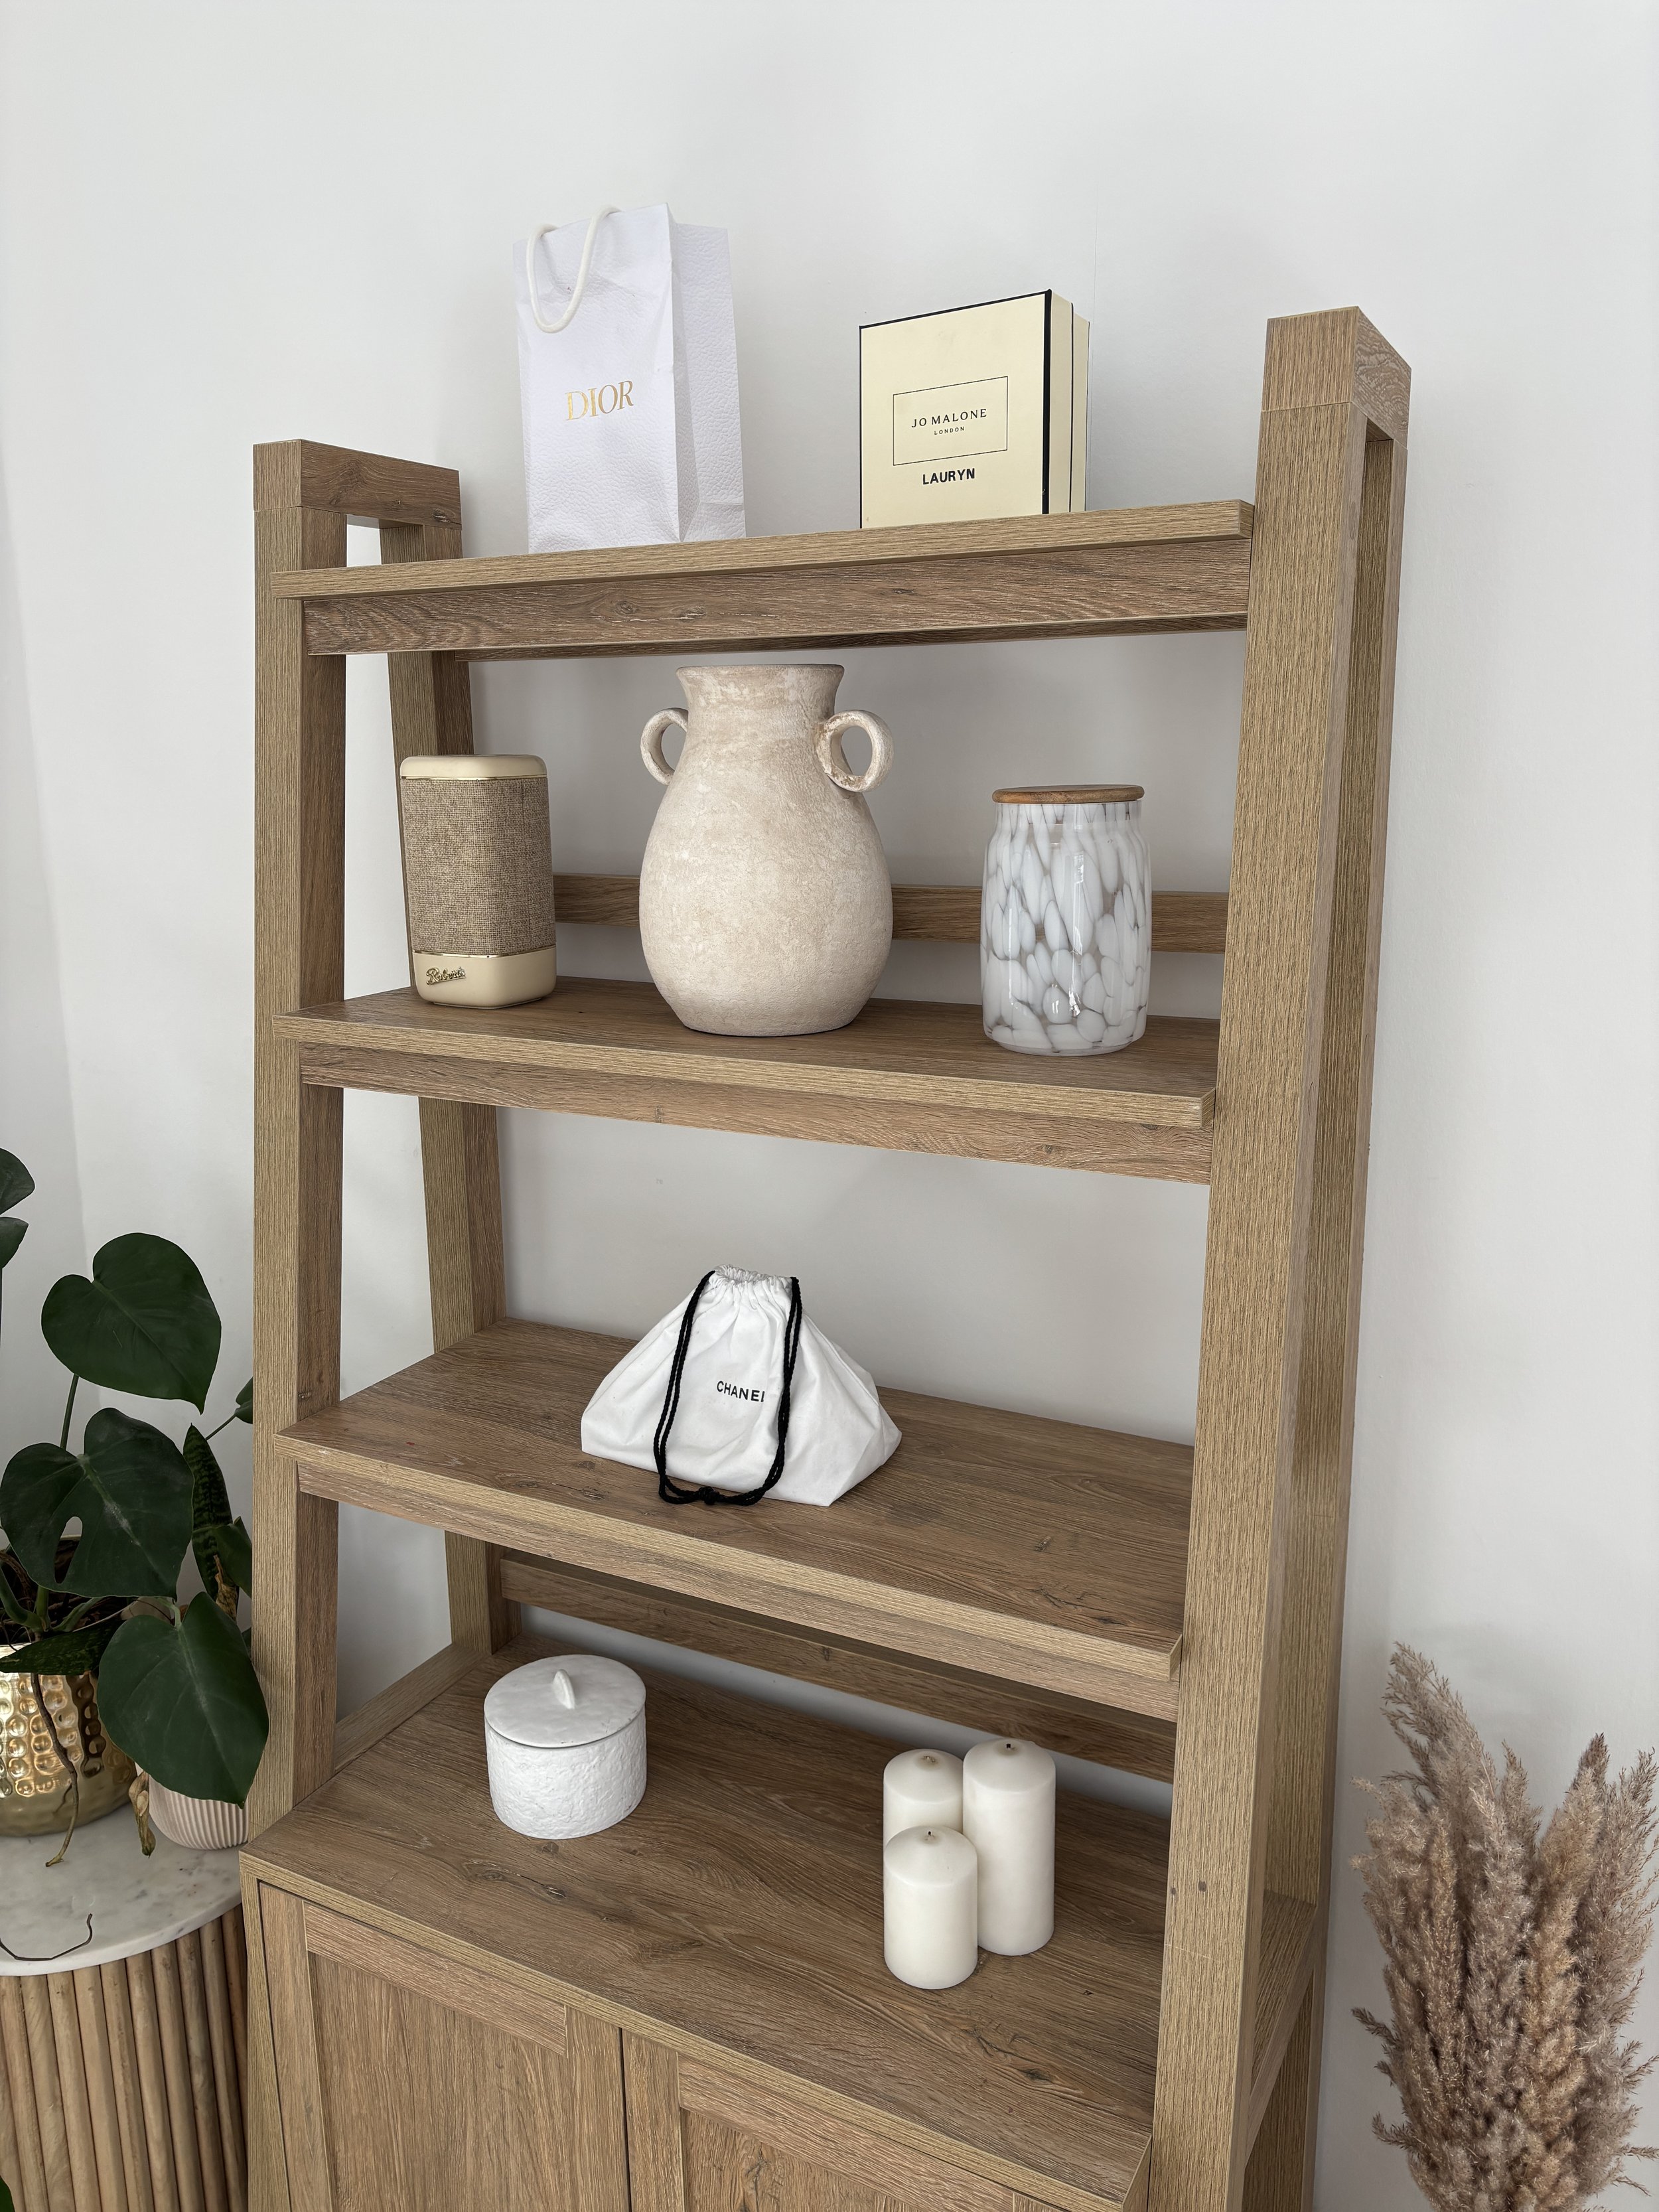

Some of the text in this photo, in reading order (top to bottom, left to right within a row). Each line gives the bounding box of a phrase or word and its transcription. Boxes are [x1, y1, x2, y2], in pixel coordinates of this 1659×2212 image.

[565, 380, 634, 421] DIOR
[911, 408, 987, 428] JO MALONE
[934, 426, 965, 435] LONDON
[922, 467, 975, 485] LAURYN
[426, 966, 466, 985] Roberts
